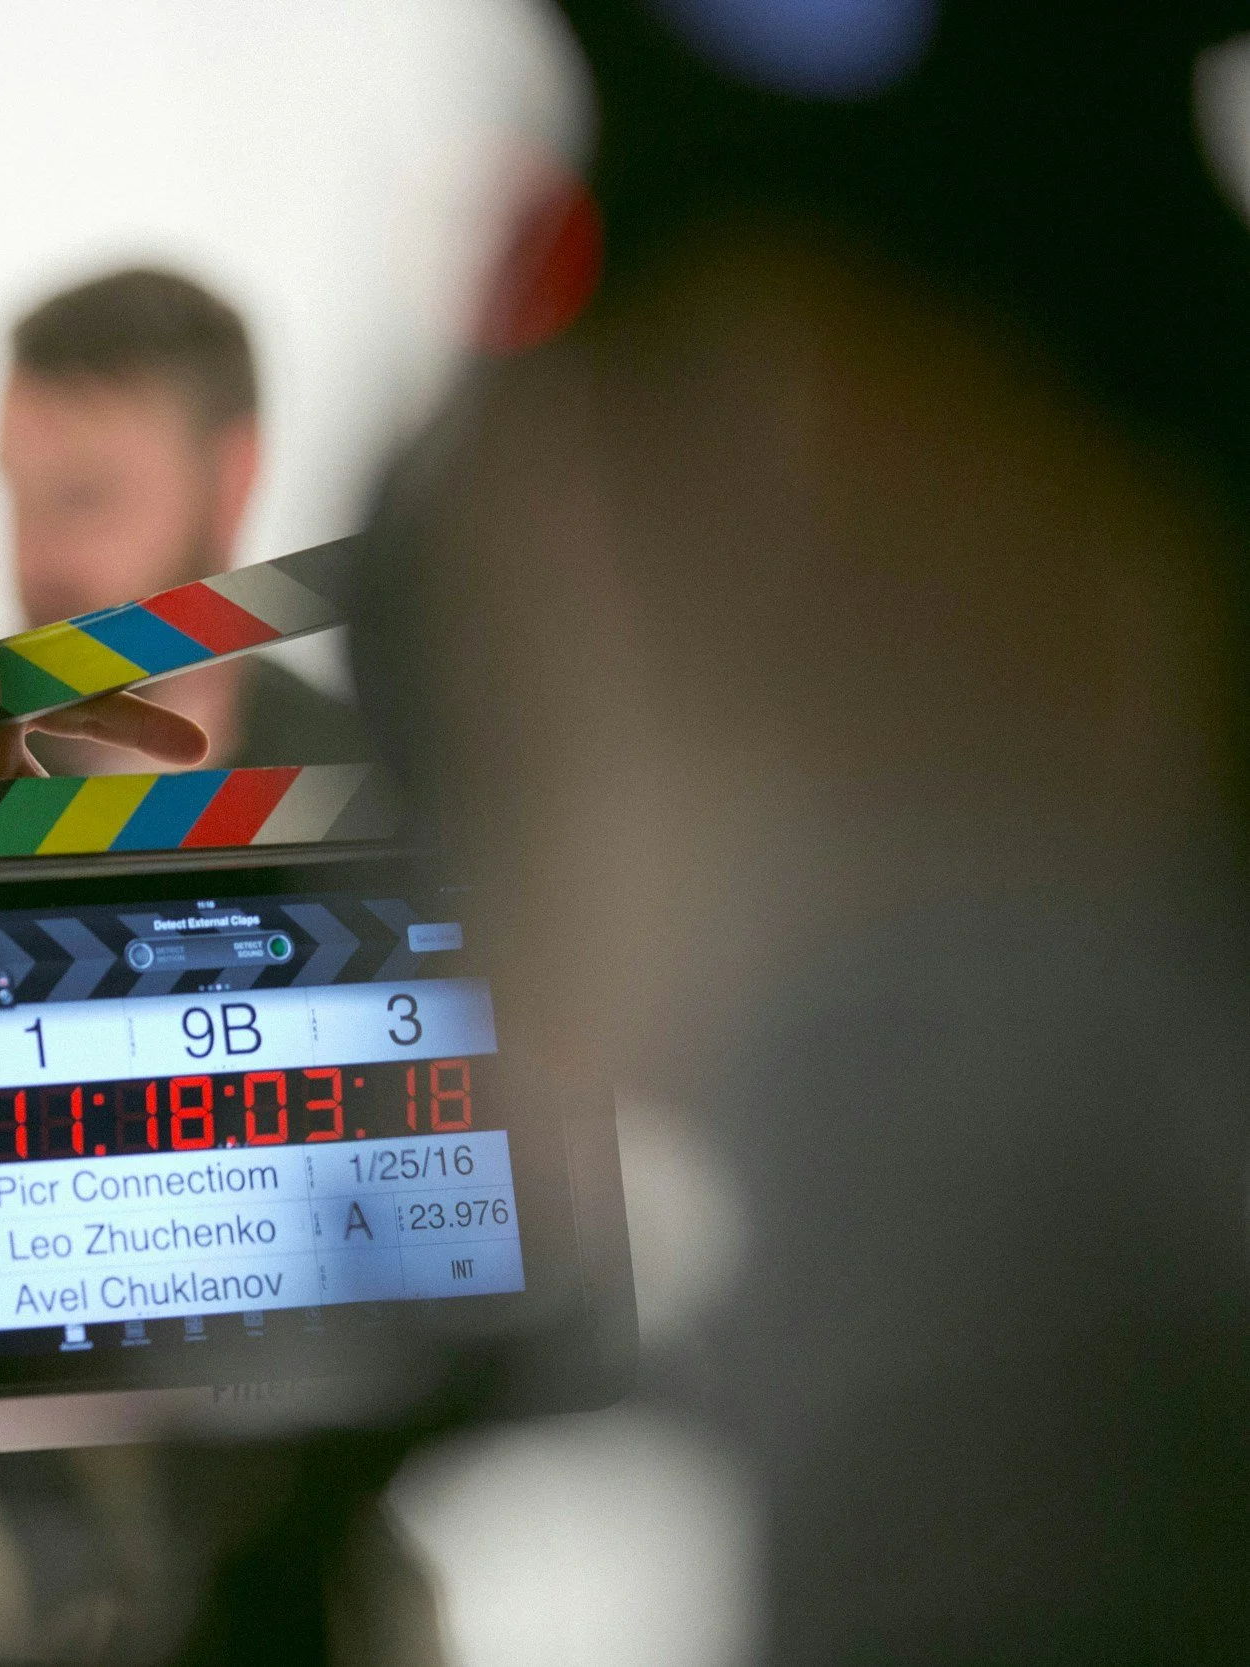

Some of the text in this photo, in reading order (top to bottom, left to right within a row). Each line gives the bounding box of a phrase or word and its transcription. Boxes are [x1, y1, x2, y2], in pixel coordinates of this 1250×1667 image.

[153, 914, 261, 931] Detect External Claps
[182, 1002, 263, 1059] 9B
[387, 993, 423, 1047] 3
[25, 1016, 46, 1069] 1
[72, 1161, 279, 1202] Connectiom
[350, 1145, 474, 1184] 1/25/16
[344, 1200, 374, 1241] A
[409, 1199, 509, 1230] 23.976
[9, 1230, 72, 1261] Leo
[84, 1214, 276, 1256] Zhuchenko
[451, 1259, 475, 1280] INT
[15, 1278, 88, 1315] Avel
[101, 1271, 283, 1310] Chuklanov
